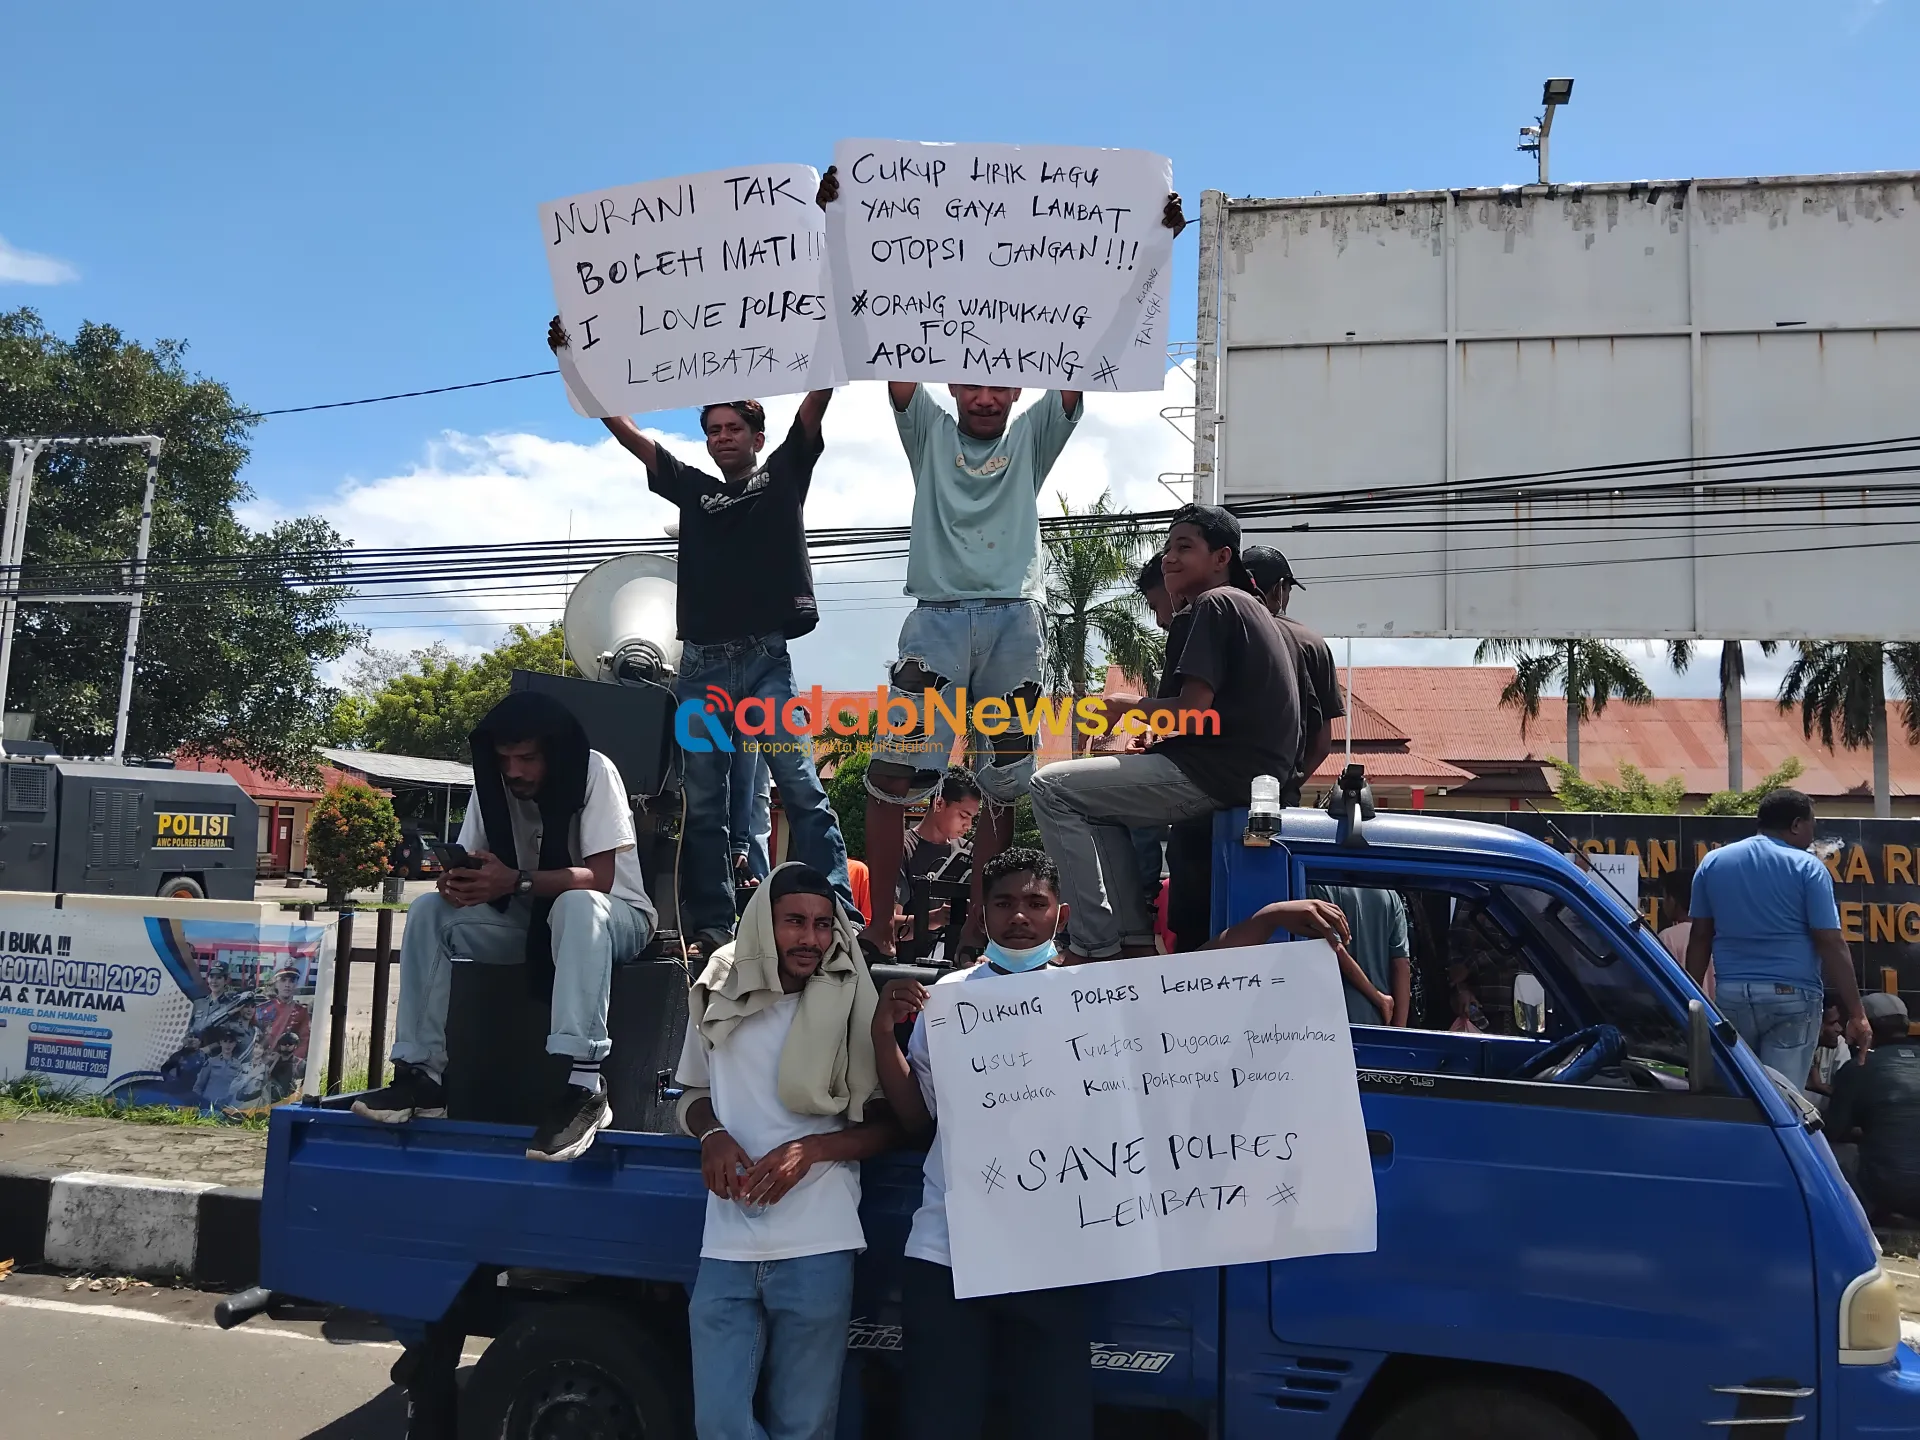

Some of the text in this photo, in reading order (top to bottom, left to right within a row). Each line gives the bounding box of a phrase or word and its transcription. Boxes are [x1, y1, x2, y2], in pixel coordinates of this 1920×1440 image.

[852, 153, 1099, 188] CUKUP LIRIK LAGU
[553, 176, 807, 245] NURANI TAK
[860, 195, 1131, 233] YANG GAYA LAMBAT
[871, 236, 965, 269] OTOPSI
[576, 247, 704, 295] BOLEH
[579, 314, 601, 350] I
[638, 302, 727, 336] LOVE
[738, 290, 826, 329] POLRES
[958, 299, 1092, 330] WAIPUKANG
[919, 319, 991, 345] FOR
[627, 345, 780, 384] LEMBATA
[866, 342, 946, 369] APOL
[962, 341, 1084, 381] MAKING
[158, 814, 229, 836] POLISI
[156, 837, 226, 848] AWC POLRES LEMBATA
[9, 931, 53, 956] BUKA
[57, 935, 71, 957] !!!
[0, 955, 161, 996] GOTA POLRI 2026
[17, 986, 29, 1003] &
[34, 987, 126, 1013] TAMTAMA
[1071, 985, 1139, 1012] POLRES
[1160, 974, 1262, 994] LEMBATA
[36, 1009, 56, 1019] DAN
[57, 1011, 99, 1023] HUMANIS
[33, 1043, 108, 1060] PENDAFTARAN ONLINE
[1160, 1031, 1231, 1054] Dugaan
[30, 1056, 40, 1066] 09
[55, 1059, 64, 1069] 30
[65, 1060, 89, 1072] MARET
[89, 1062, 108, 1074] 2026
[1409, 1076, 1435, 1088] 1.5
[1017, 1136, 1147, 1191] SAVE
[1168, 1132, 1298, 1170] POLRES
[1078, 1184, 1250, 1228] LEMBATA
